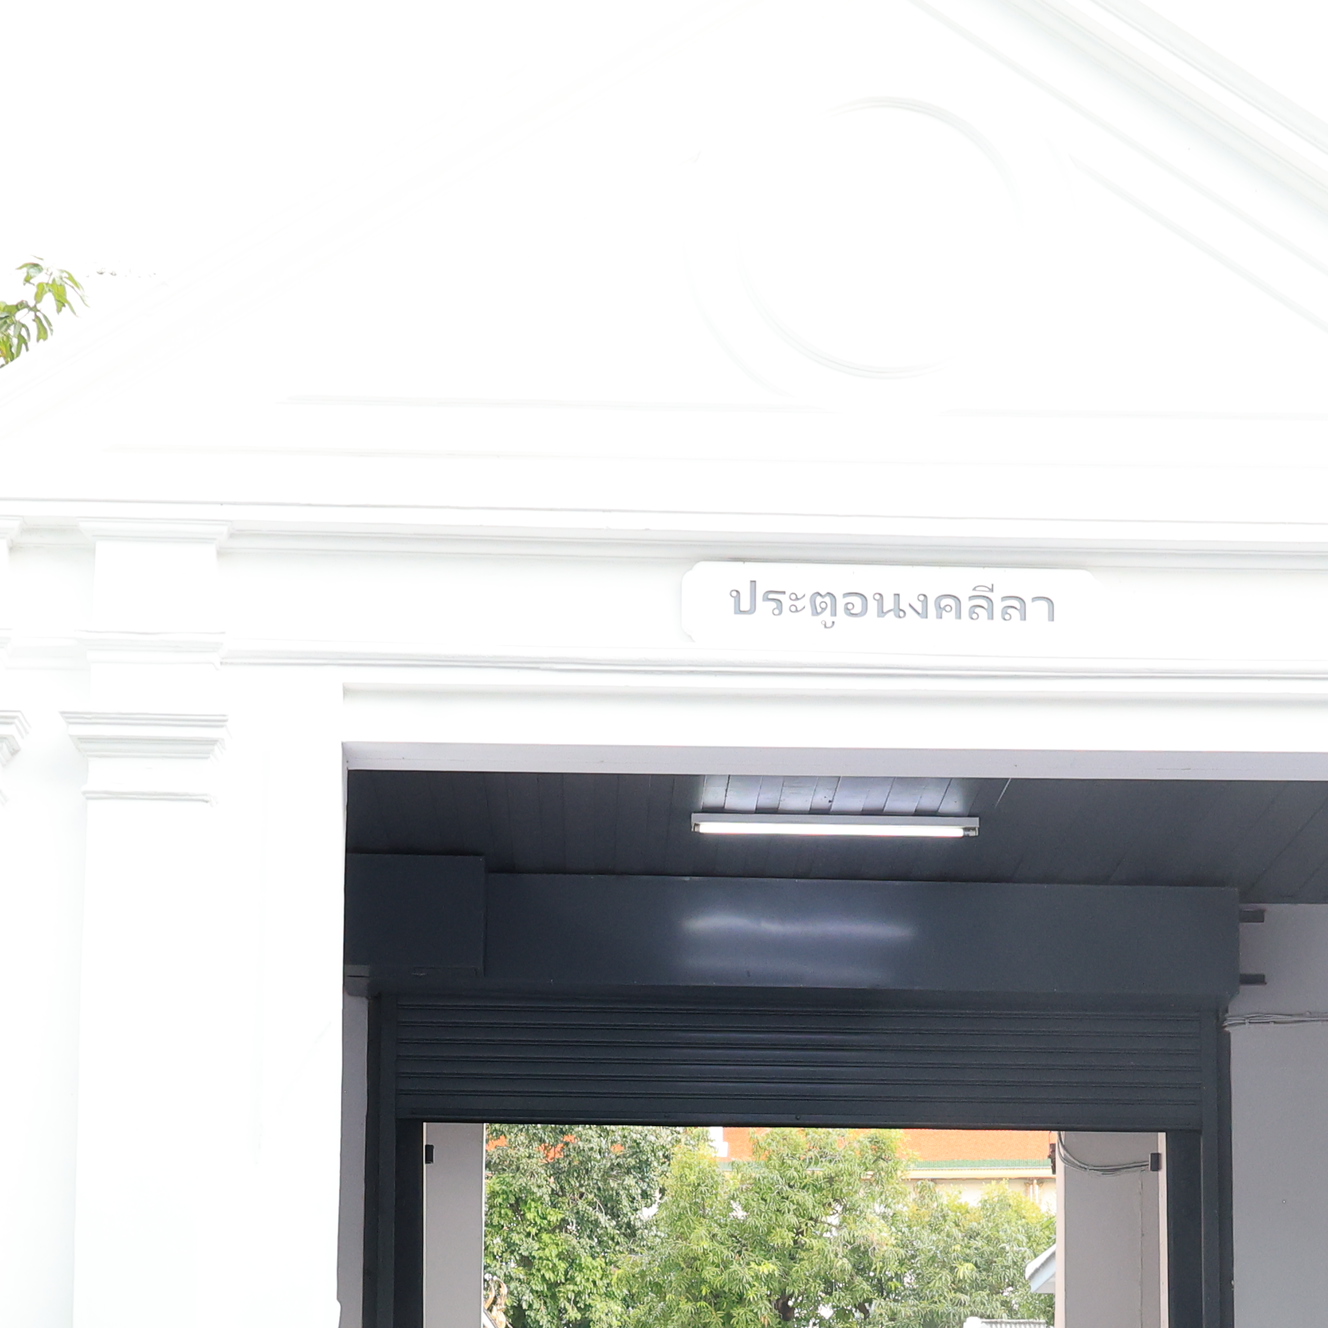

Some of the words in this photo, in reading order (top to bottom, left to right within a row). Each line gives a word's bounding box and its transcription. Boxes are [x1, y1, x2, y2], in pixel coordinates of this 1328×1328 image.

[729, 579, 1055, 629] ประตูอนงคลีลา
